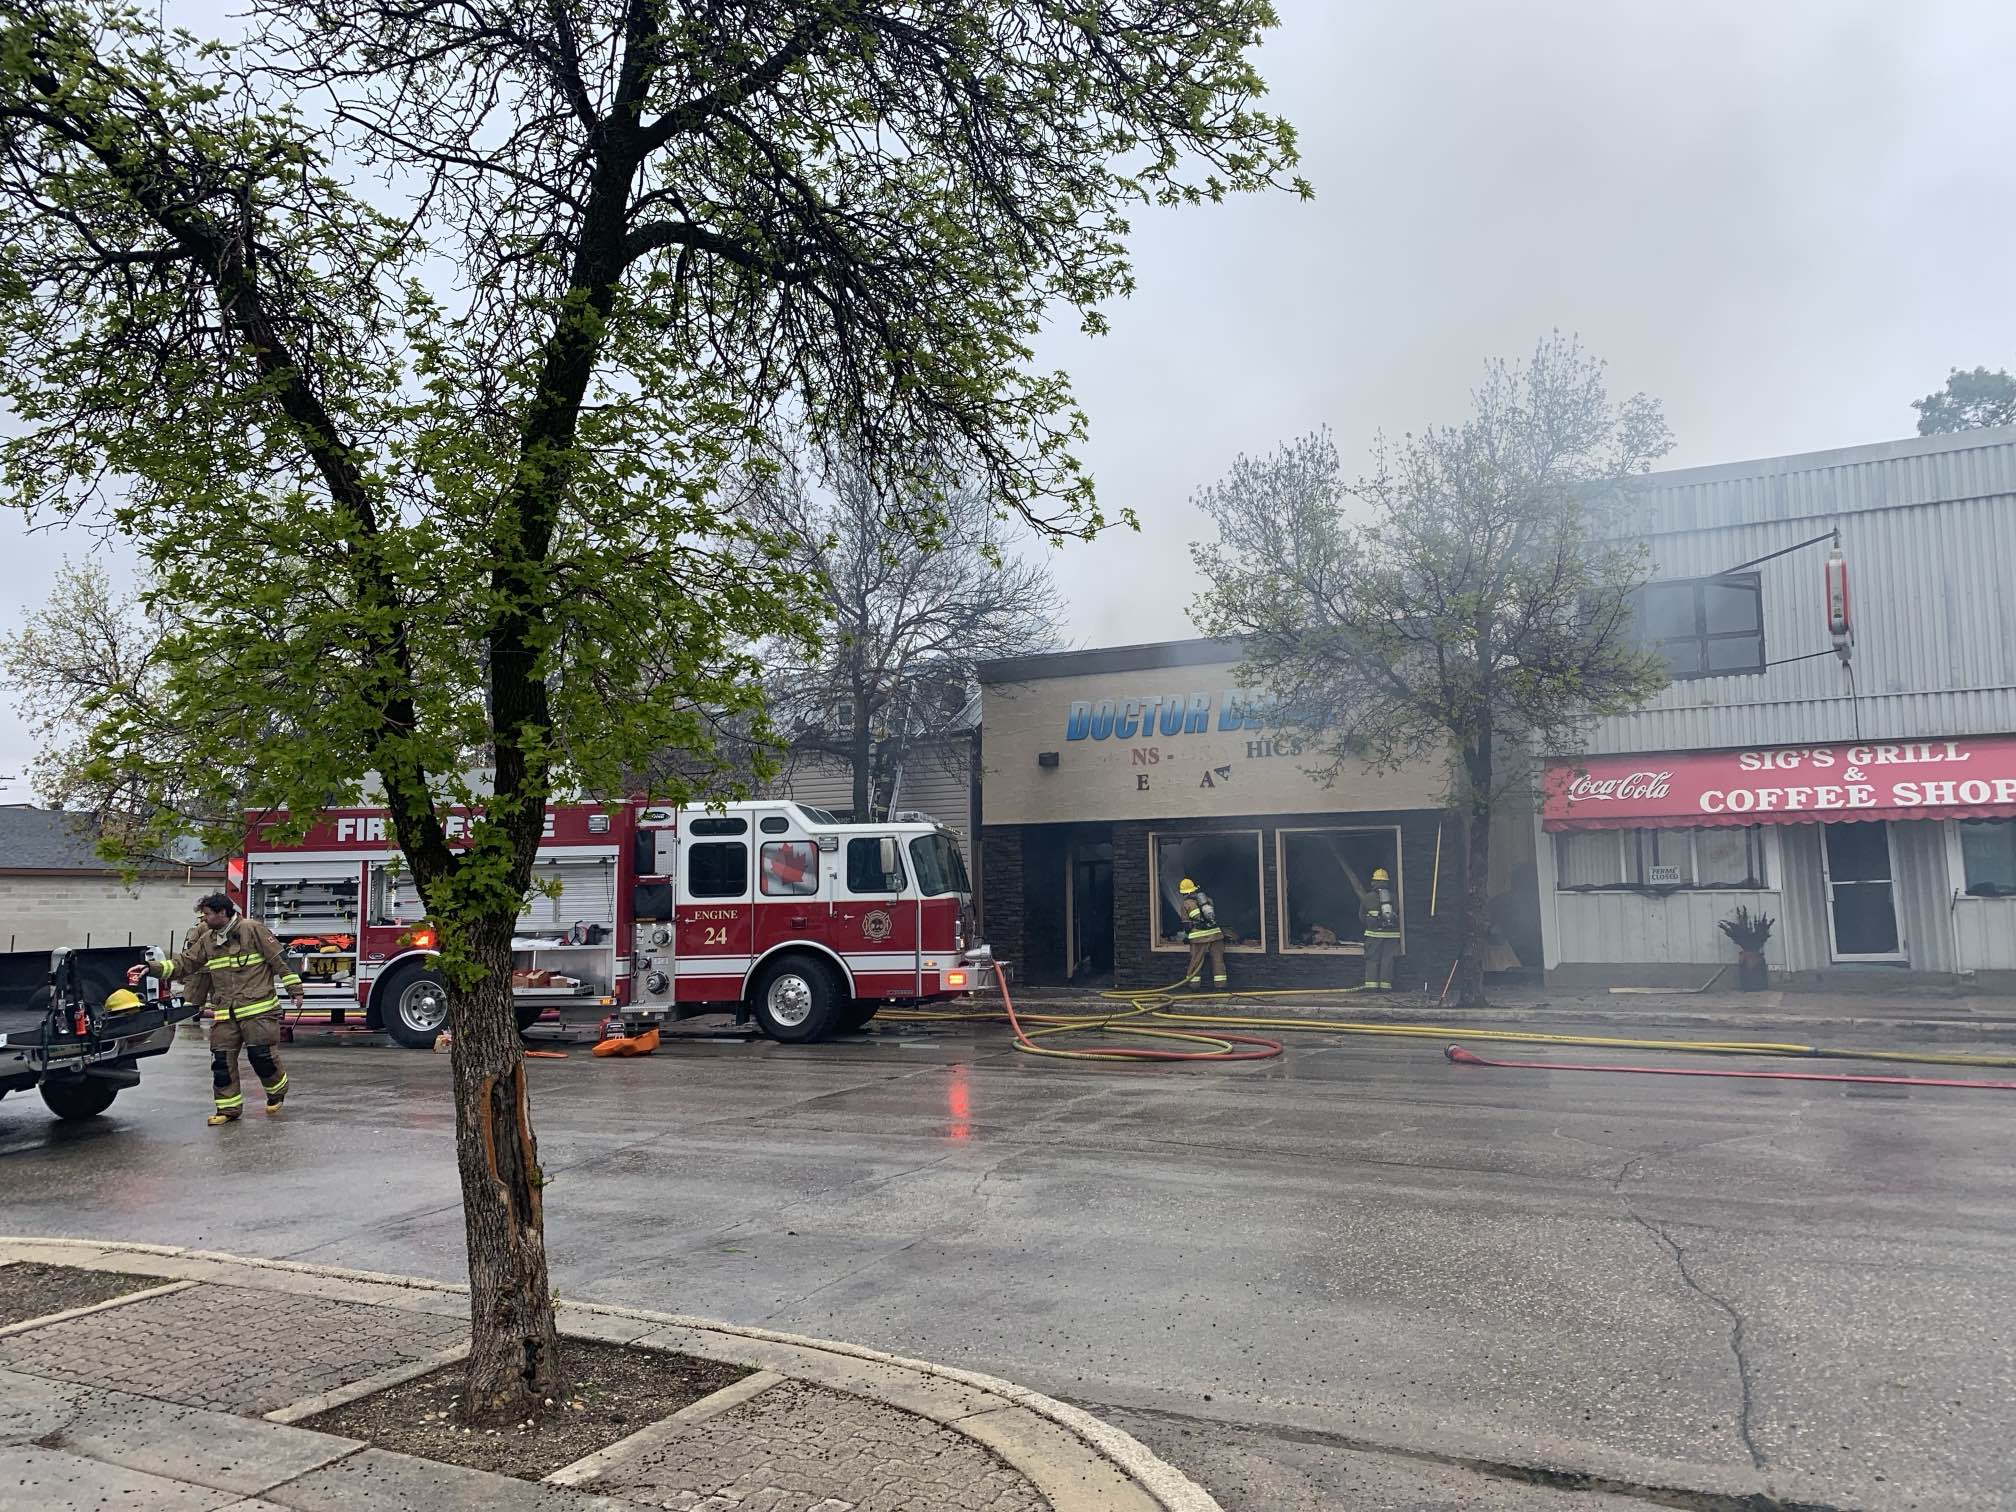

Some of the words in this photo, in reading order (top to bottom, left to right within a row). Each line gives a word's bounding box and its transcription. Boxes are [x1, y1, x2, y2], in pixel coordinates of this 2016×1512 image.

[1066, 690, 1211, 741] DOCTOR
[1739, 749, 1835, 771] SIG'S
[1847, 742, 1971, 766] GRILL
[1136, 774, 1150, 791] E
[1843, 766, 1868, 782] &
[1700, 784, 1877, 813] COFFEE
[1893, 779, 2016, 806] SHOP
[338, 816, 396, 842] FIR
[694, 910, 738, 920] ENGINE
[703, 926, 728, 945] 24
